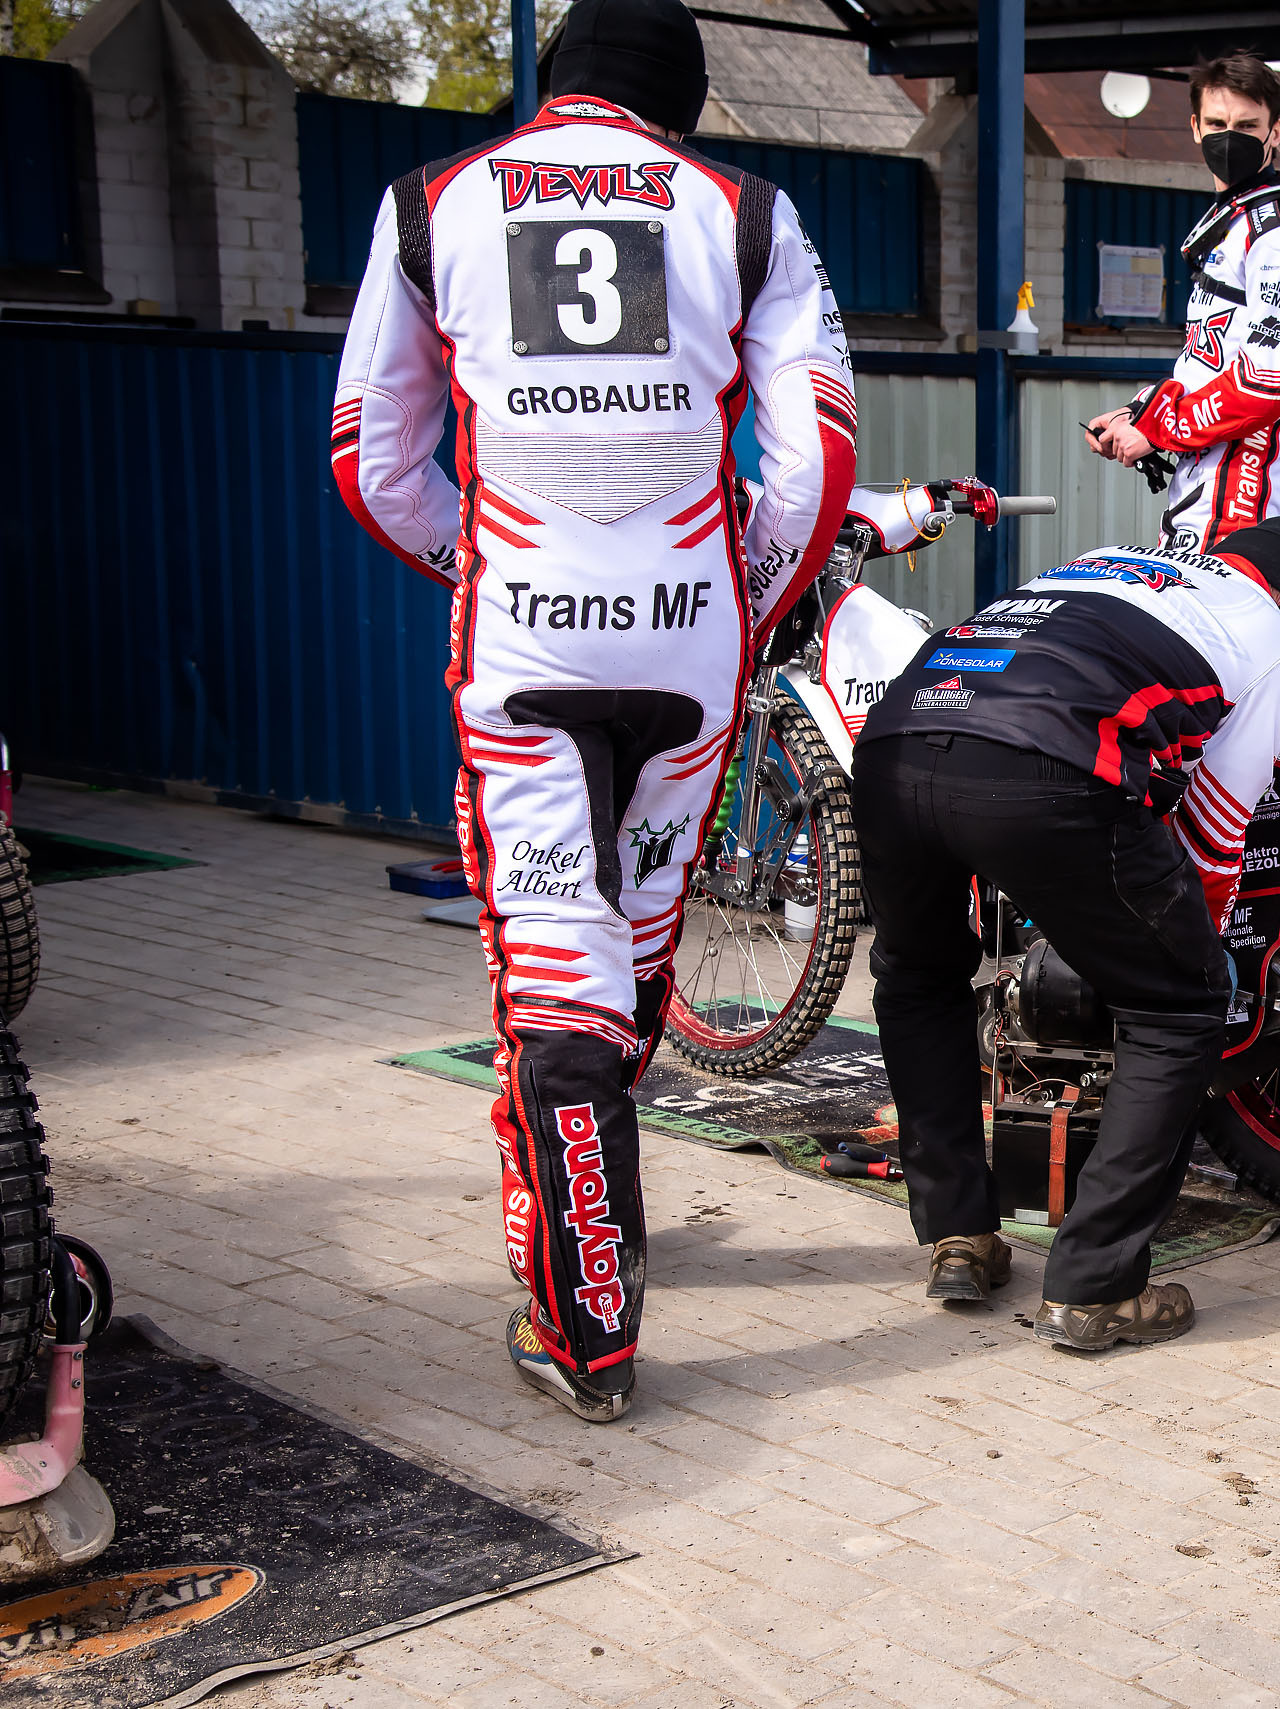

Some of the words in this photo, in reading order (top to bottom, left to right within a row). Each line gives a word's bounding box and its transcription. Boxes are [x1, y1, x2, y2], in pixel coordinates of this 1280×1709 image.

[488, 158, 680, 213] DEVILS
[555, 228, 622, 347] 3
[507, 383, 692, 415] GROBAUER
[1193, 390, 1224, 431] MF
[1228, 451, 1261, 519] Trans
[505, 582, 636, 631] Trans
[651, 580, 712, 630] MF
[995, 614, 1045, 626] Schwaiger
[940, 657, 1004, 668] ONESOLAR
[512, 840, 591, 874] Onkel
[1242, 846, 1280, 862] lektro
[496, 869, 582, 899] Albert
[1234, 907, 1253, 924] MF
[1230, 935, 1266, 949] Spedition
[651, 1053, 886, 1113] SCHAFF
[554, 1102, 627, 1319] daytona
[600, 1293, 618, 1332] FREY
